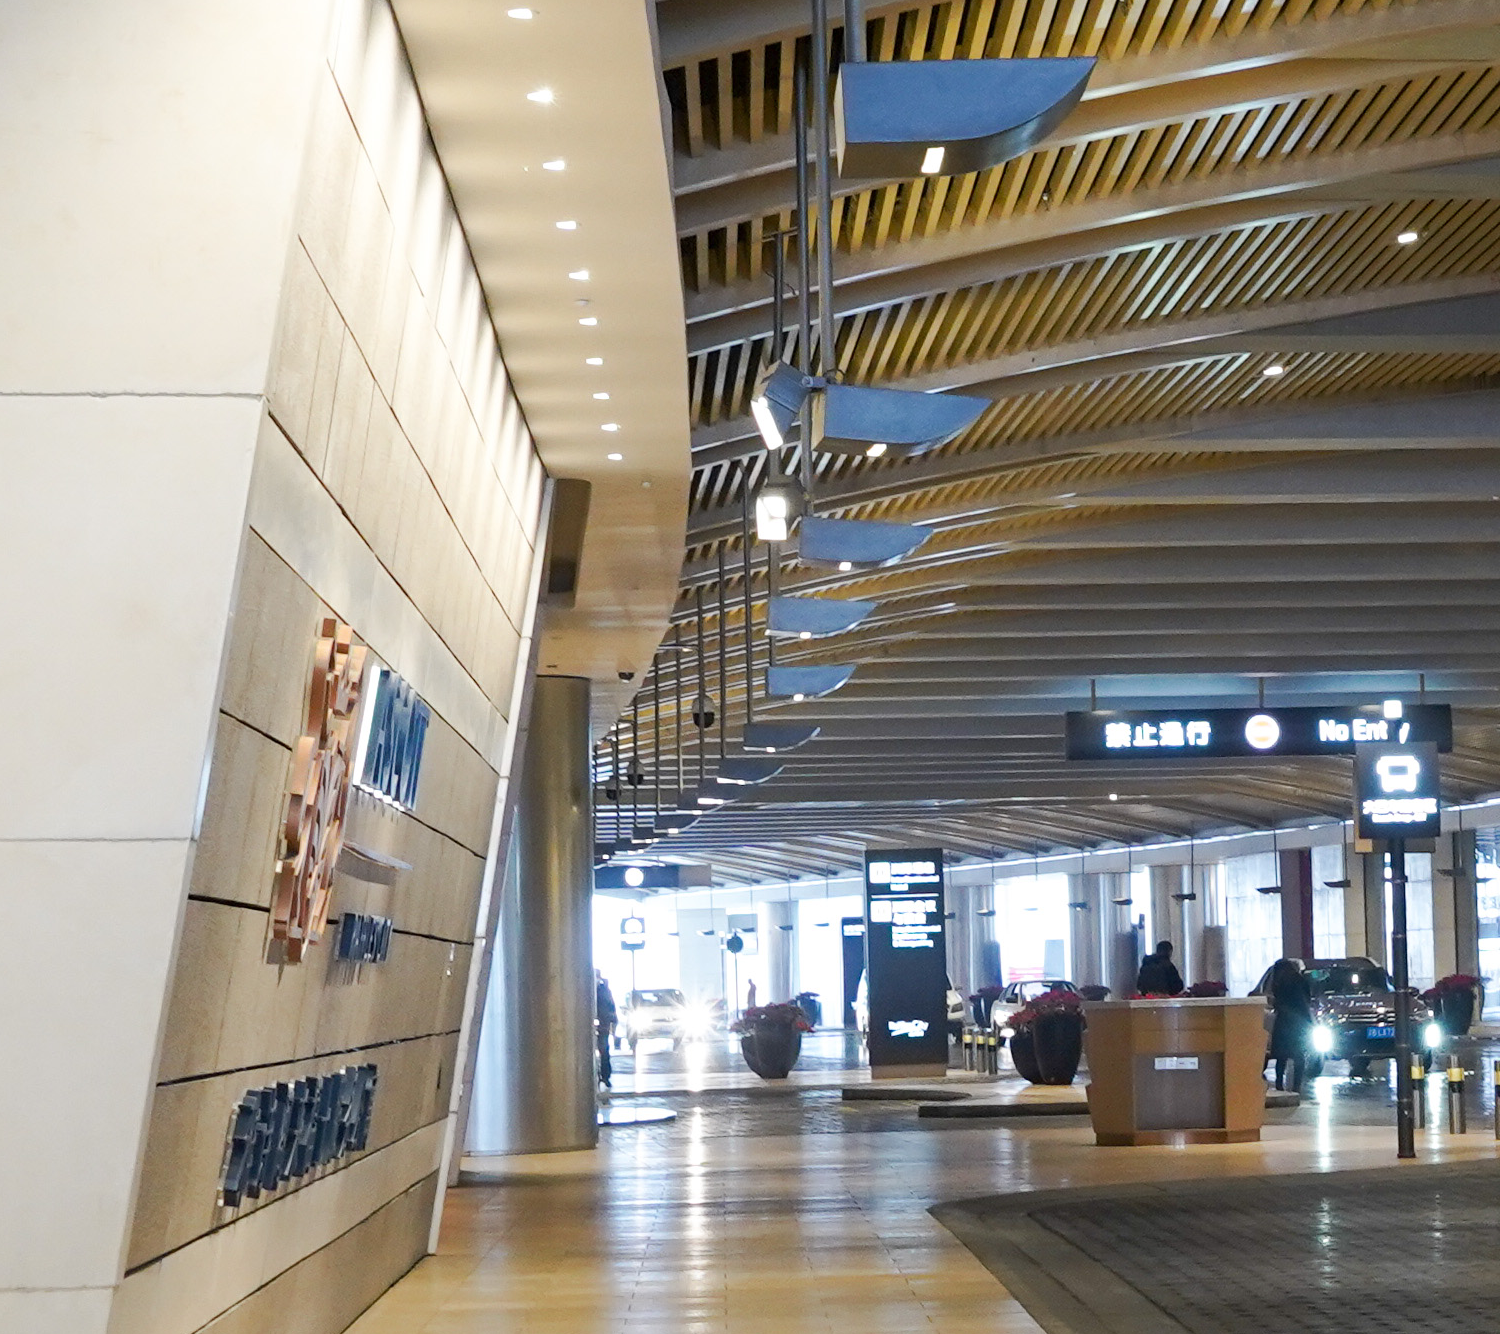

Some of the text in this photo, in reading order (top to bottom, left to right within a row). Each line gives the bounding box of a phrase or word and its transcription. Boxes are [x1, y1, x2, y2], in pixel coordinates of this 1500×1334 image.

[1105, 720, 1212, 748] 禁止通行
[1319, 718, 1411, 744] No Enty
